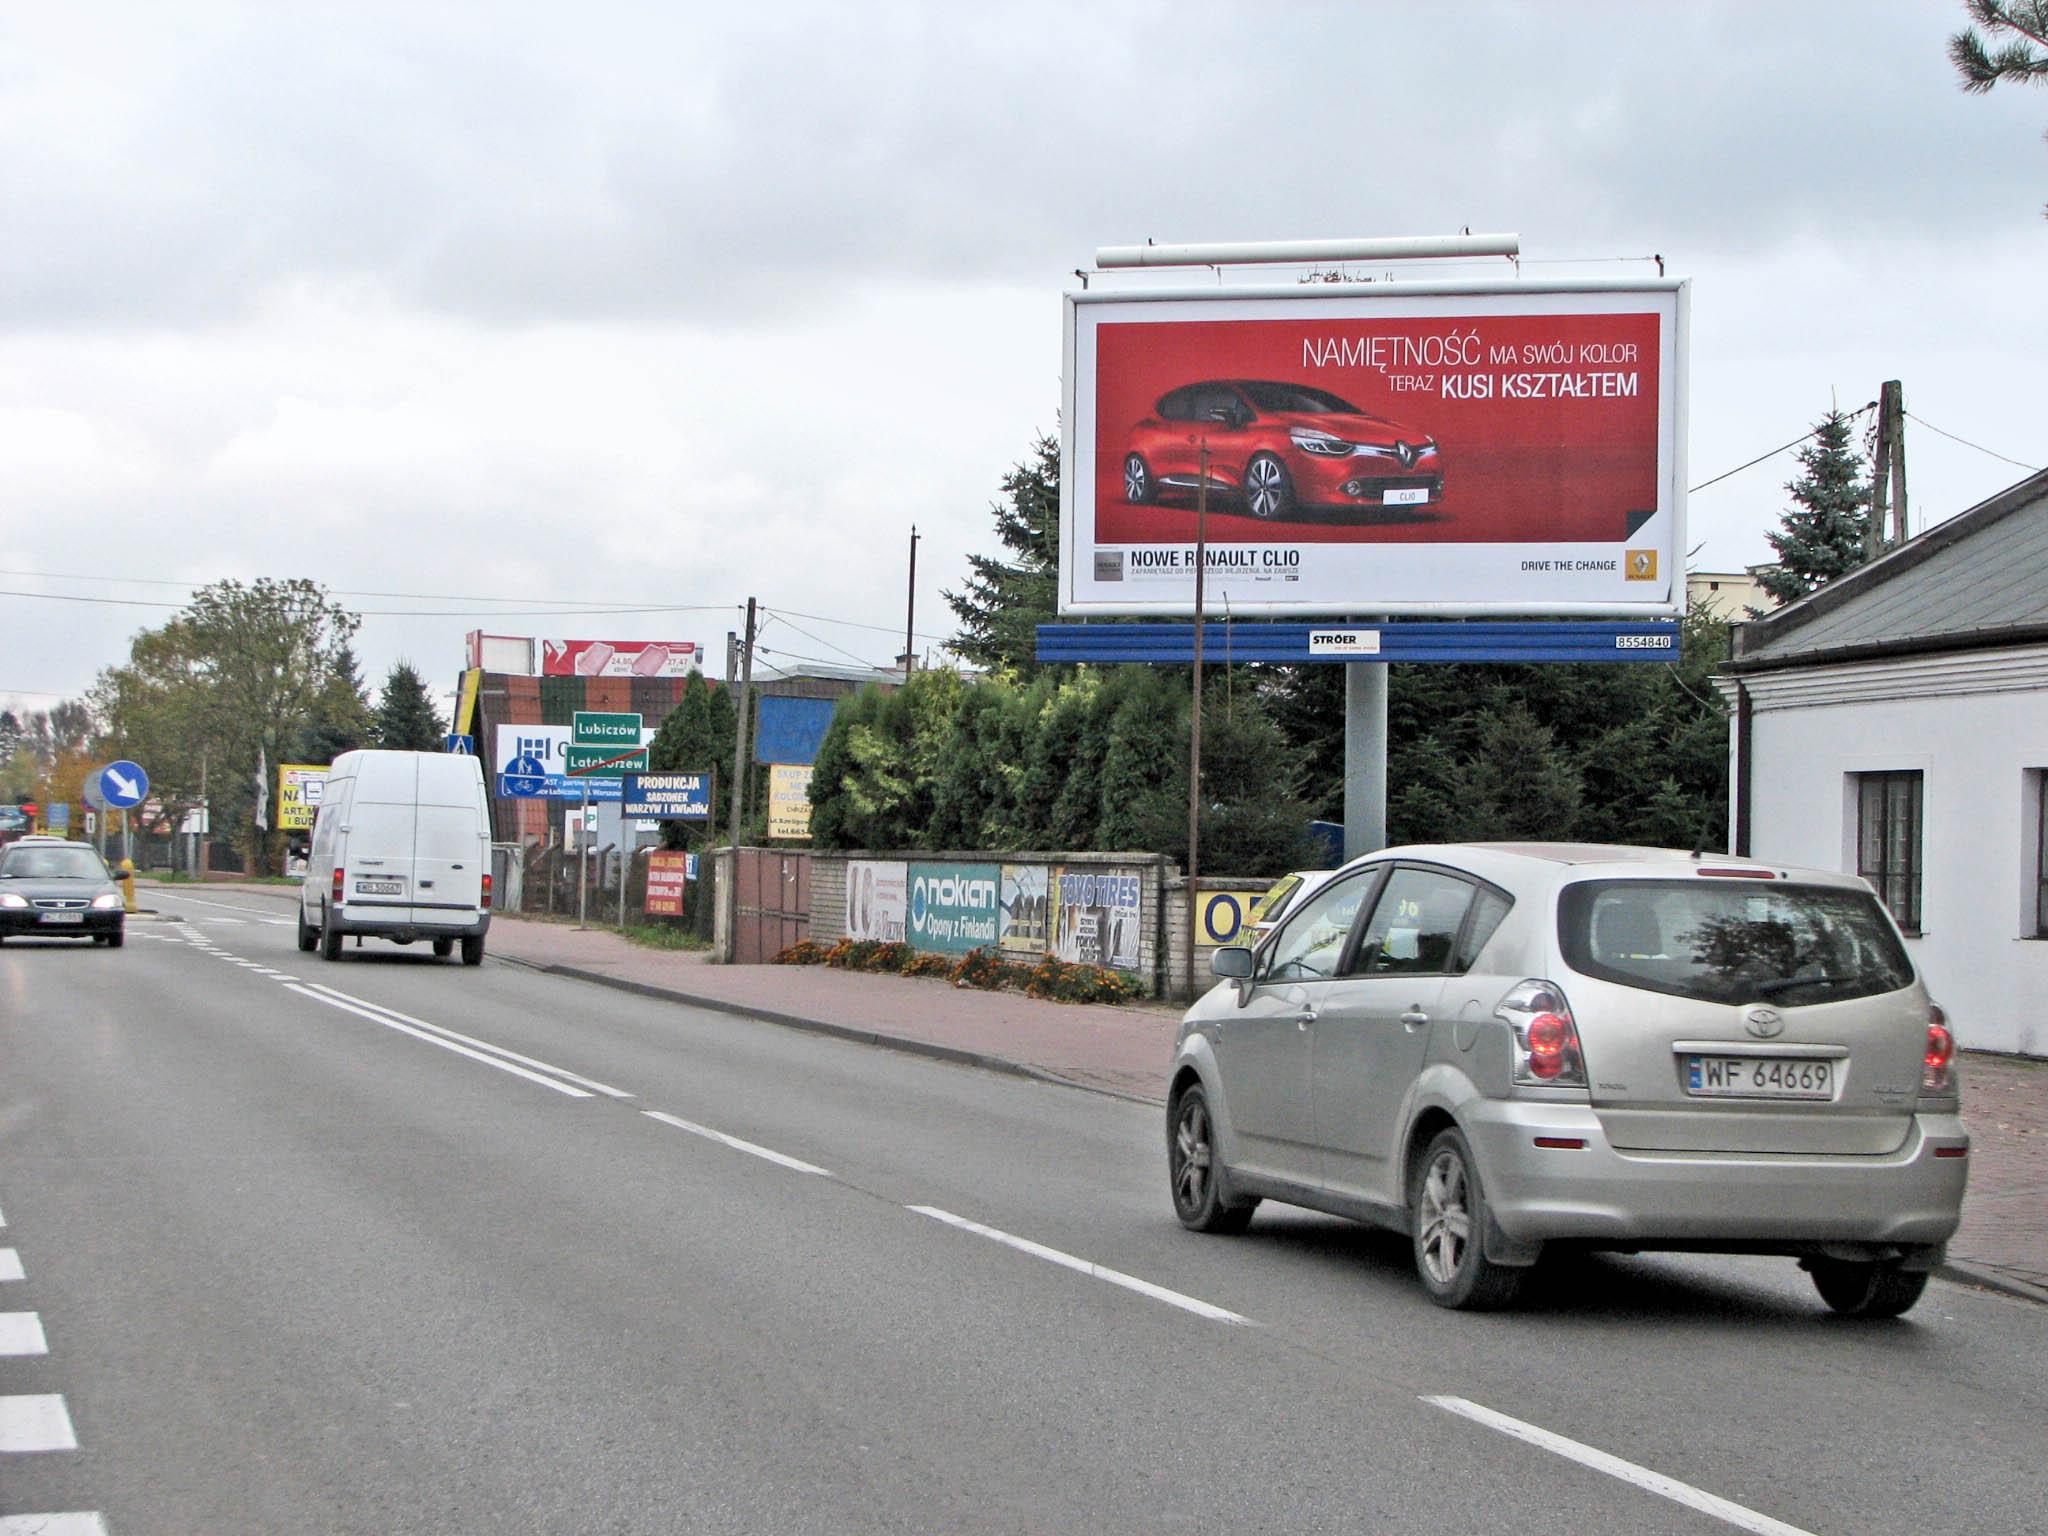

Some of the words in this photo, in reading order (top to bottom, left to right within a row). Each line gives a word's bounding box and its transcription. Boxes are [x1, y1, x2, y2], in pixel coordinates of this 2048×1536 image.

[1303, 329, 1481, 373] NAMIĘTNOŚĆ
[1490, 346, 1517, 365] MA
[1523, 340, 1573, 364] SWÓJ
[1580, 344, 1637, 363] KOLOR
[1388, 375, 1434, 391] TERAZ
[1442, 374, 1493, 398] KUSI
[1502, 372, 1638, 398] KSZTAŁTEM
[1399, 491, 1416, 502] CLIO
[1131, 551, 1179, 567] NOWE
[1185, 550, 1258, 567] RNAULT
[1263, 550, 1300, 567] CLIO
[1521, 561, 1551, 571] DRIVE
[1554, 561, 1573, 571] THE
[1575, 560, 1617, 571] CHANGE
[1313, 634, 1357, 645] STRÖER
[1618, 637, 1669, 648] 8554840
[578, 723, 637, 737] Lubiczów
[570, 756, 644, 770] Latchorzew
[637, 776, 700, 790] PRODUKCJA
[625, 803, 662, 814] WARZYW
[927, 873, 996, 909] nokian
[1058, 874, 1096, 907] TOYO
[1096, 875, 1140, 908] TIRES
[927, 912, 952, 942] Opony
[954, 920, 959, 937] z
[960, 915, 995, 941] Finlandii
[1705, 1061, 1742, 1087] WF
[1753, 1062, 1827, 1091] 64669
